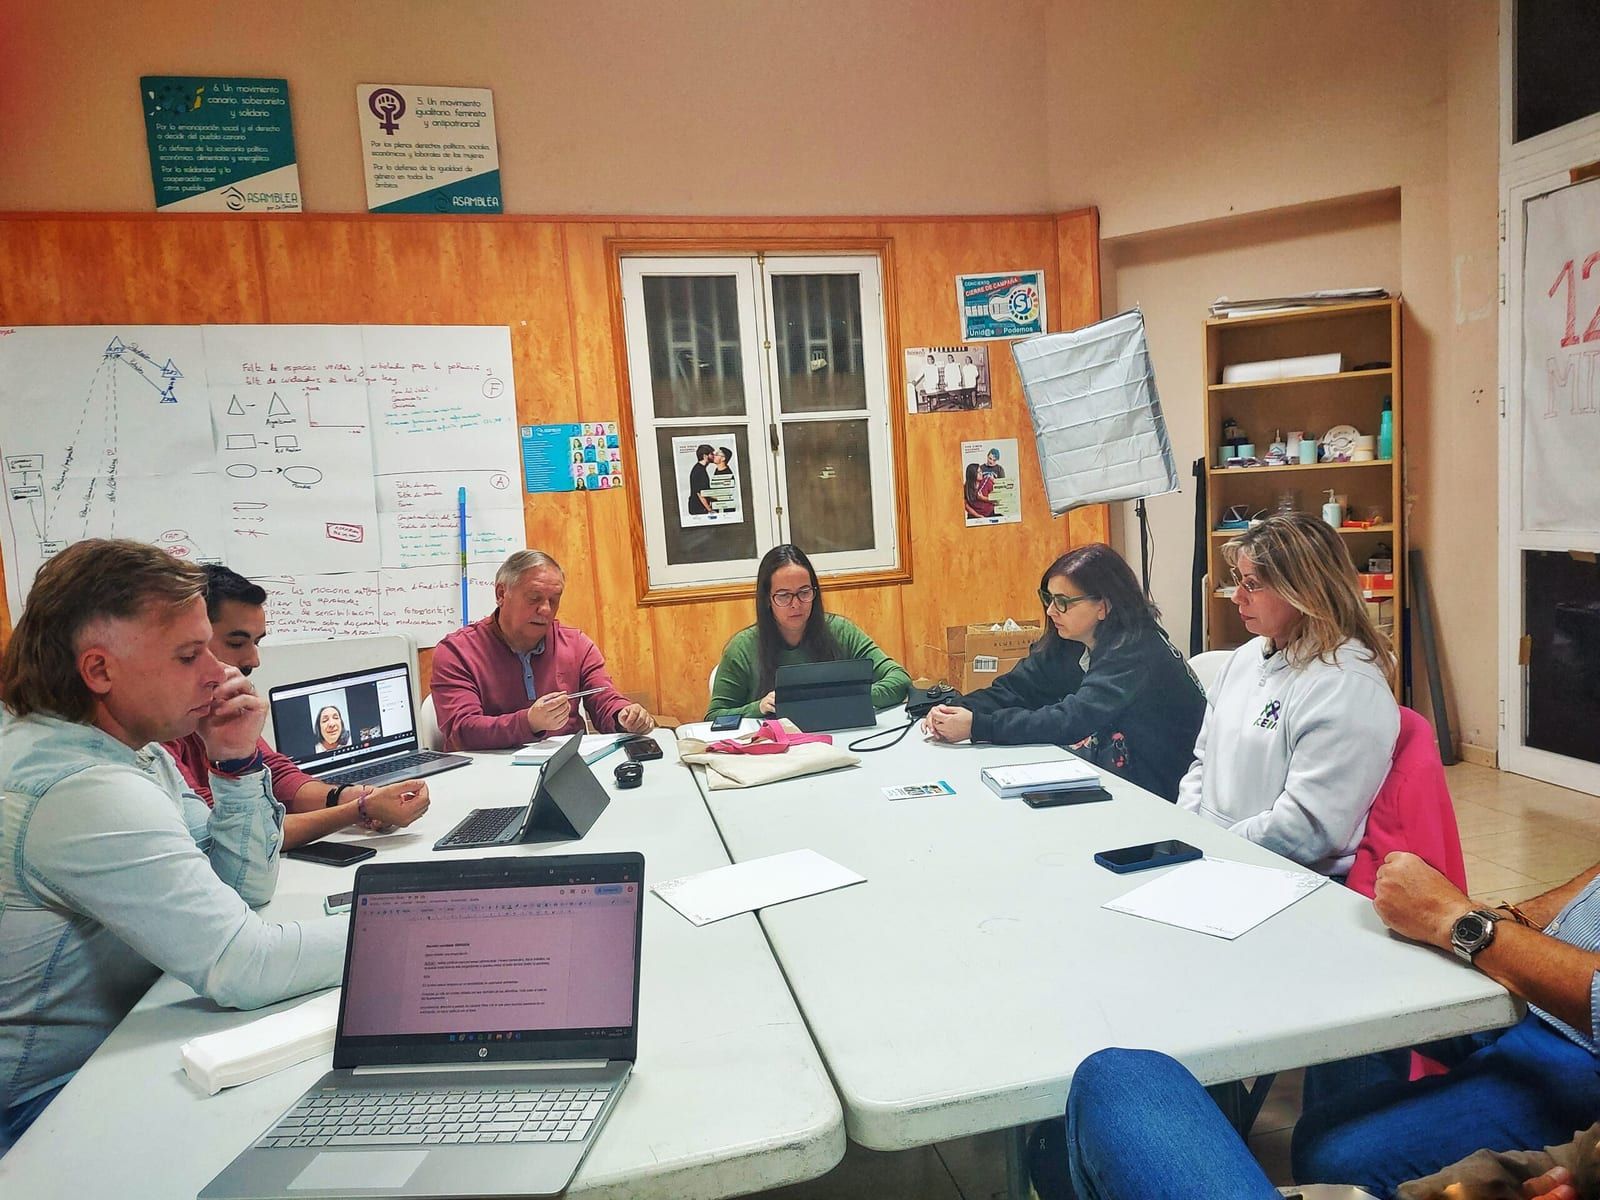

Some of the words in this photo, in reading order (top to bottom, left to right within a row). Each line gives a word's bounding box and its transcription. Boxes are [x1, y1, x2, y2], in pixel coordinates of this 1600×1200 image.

[222, 84, 234, 92] Un
[236, 85, 280, 94] movimiento
[427, 98, 438, 106] Un
[440, 98, 481, 108] movimiento
[454, 108, 487, 118] feminista
[432, 119, 480, 128] antipatriarcal
[241, 125, 246, 133] y
[199, 133, 222, 142] pueblo
[158, 144, 167, 152] En
[195, 144, 204, 152] de
[438, 165, 464, 173] igualdad
[247, 192, 298, 204] ASAMBLEA
[452, 196, 500, 208] ASAMBLEA
[965, 287, 986, 297] CIERRE
[1003, 326, 1034, 334] Podemos
[490, 382, 501, 396] F
[496, 476, 505, 488] A
